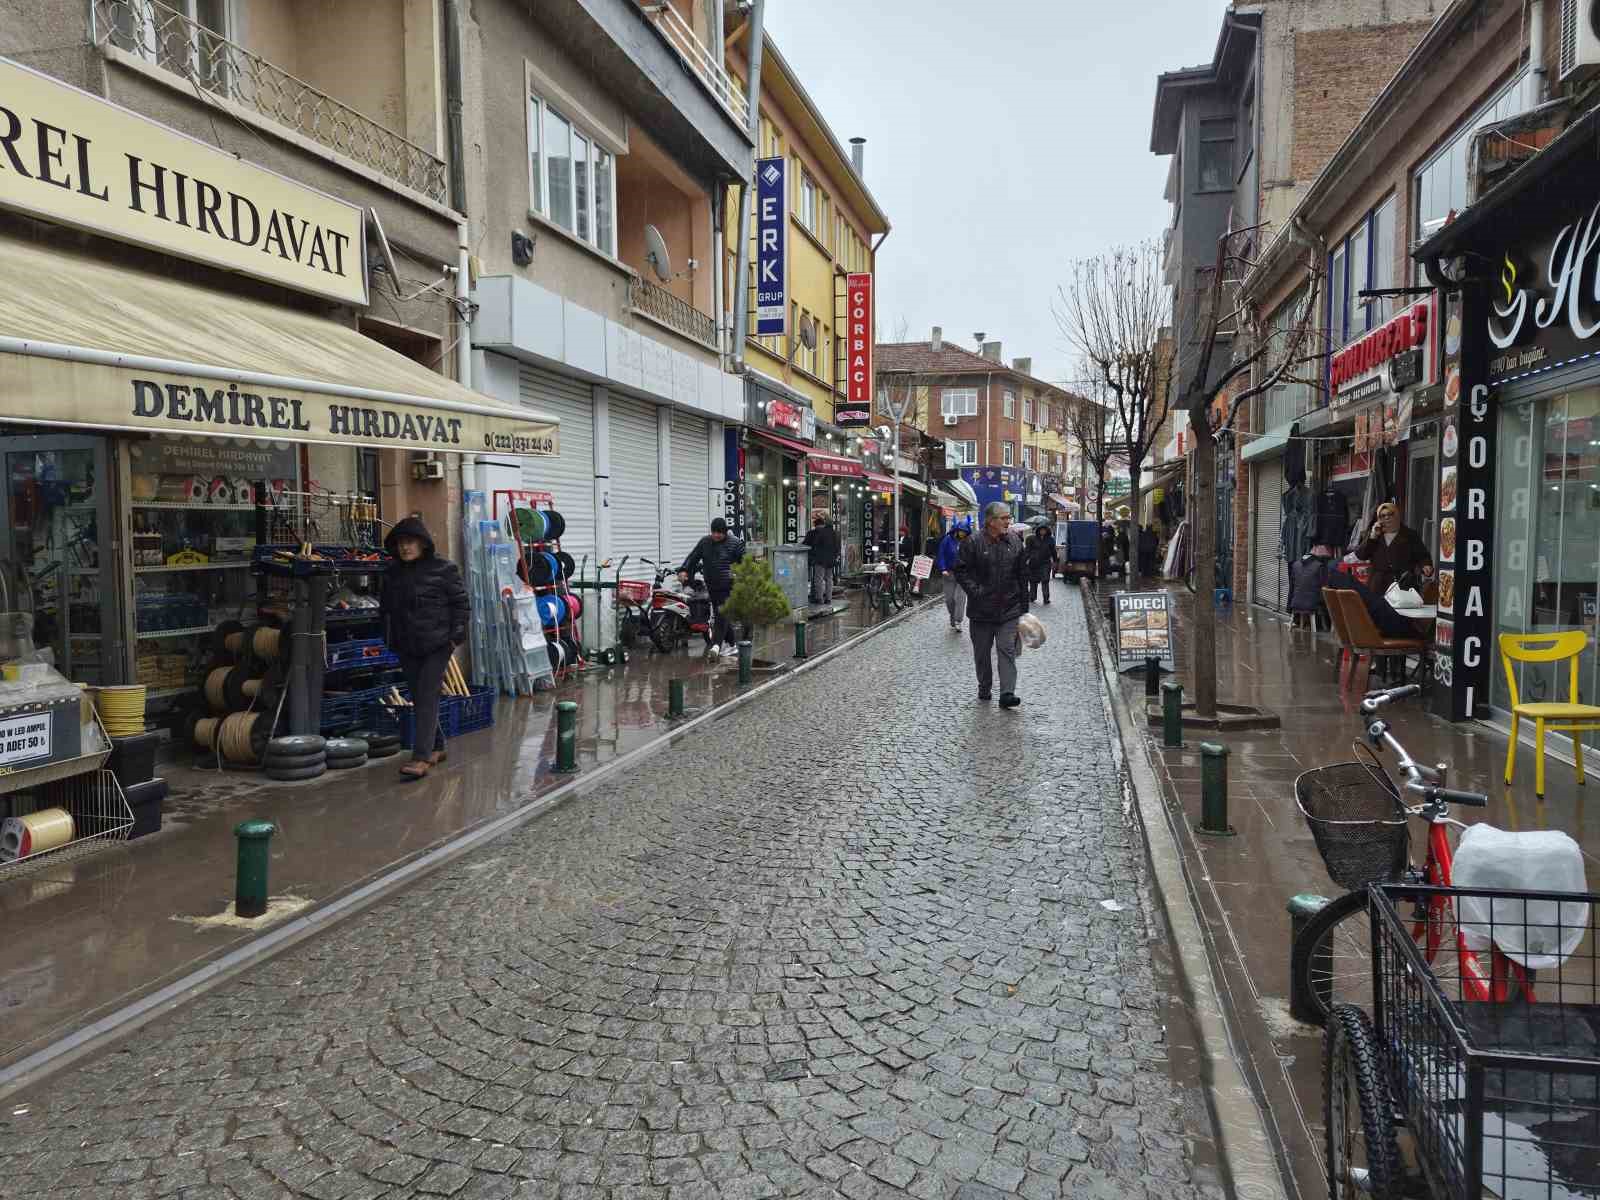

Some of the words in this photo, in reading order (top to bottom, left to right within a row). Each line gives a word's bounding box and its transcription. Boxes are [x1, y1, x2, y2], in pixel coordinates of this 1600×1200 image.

[124, 153, 349, 278] HIRDAVAT
[762, 198, 778, 282] ERK
[758, 291, 784, 302] GRUP
[853, 292, 865, 399] ÇORBACI
[131, 379, 311, 431] DEMİREL
[328, 404, 462, 444] HIRDAVAT
[1463, 384, 1488, 717] ÇORBACI
[1120, 596, 1167, 610] PİDECİ
[6, 738, 26, 753] ADET
[28, 736, 39, 749] 50
